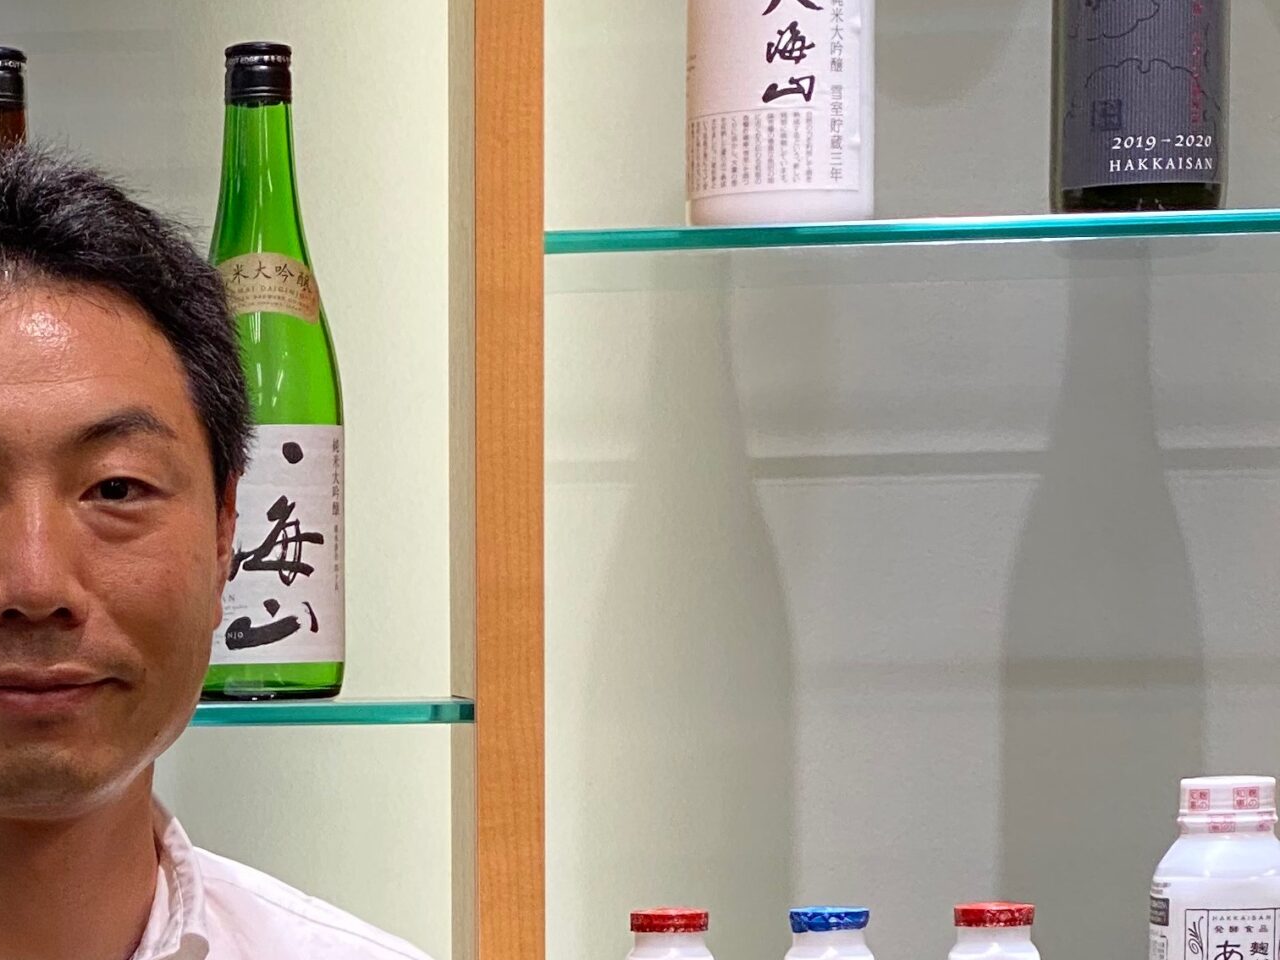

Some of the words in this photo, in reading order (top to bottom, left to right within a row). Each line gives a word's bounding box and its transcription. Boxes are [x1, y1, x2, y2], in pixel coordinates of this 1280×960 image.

[829, 84, 843, 182] 雪室貯蔵三年
[1108, 157, 1214, 172] HAKKAISAN
[225, 259, 313, 293] 米大吟醸
[1214, 925, 1269, 933] 発酵食品
